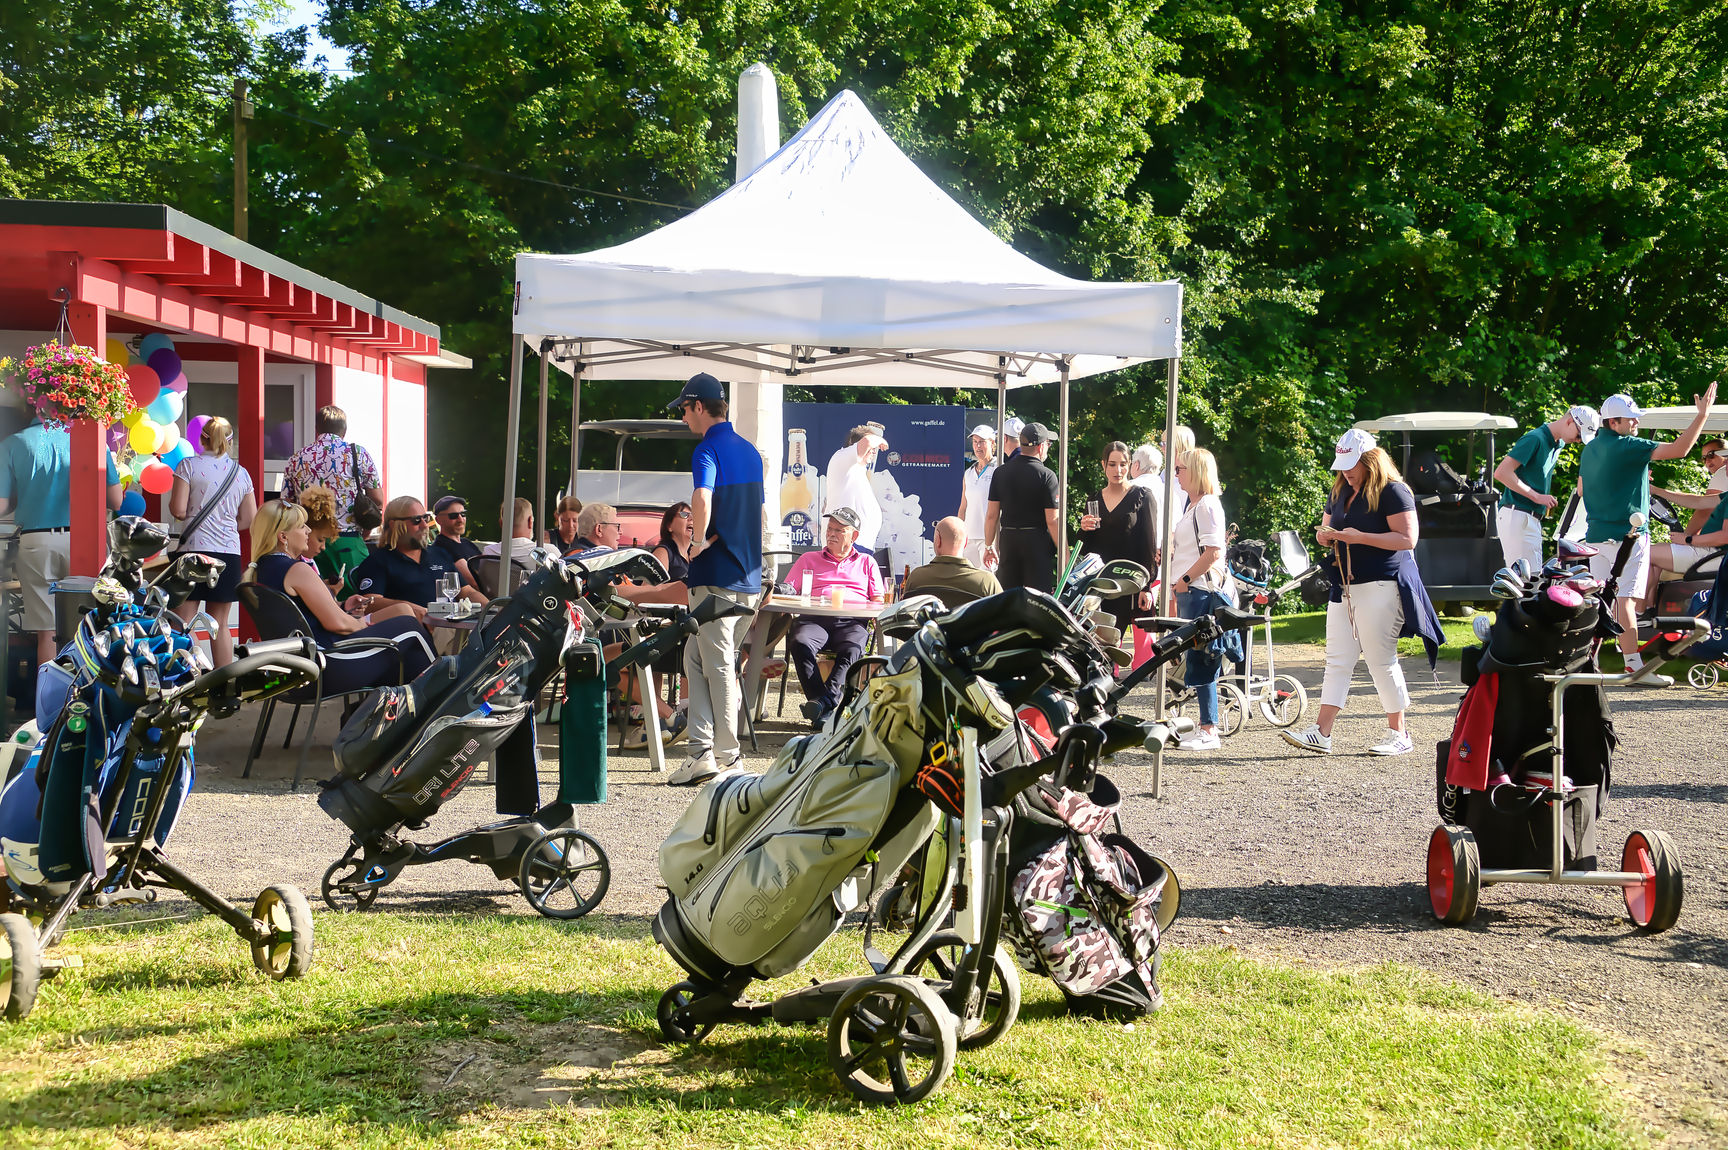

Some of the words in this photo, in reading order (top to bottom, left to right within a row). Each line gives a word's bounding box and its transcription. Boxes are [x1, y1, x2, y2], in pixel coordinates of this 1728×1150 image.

[1112, 566, 1143, 580] EPIC
[441, 765, 474, 798] SILENCIO
[683, 862, 704, 884] 14.0
[763, 896, 797, 931] SILENCIO
